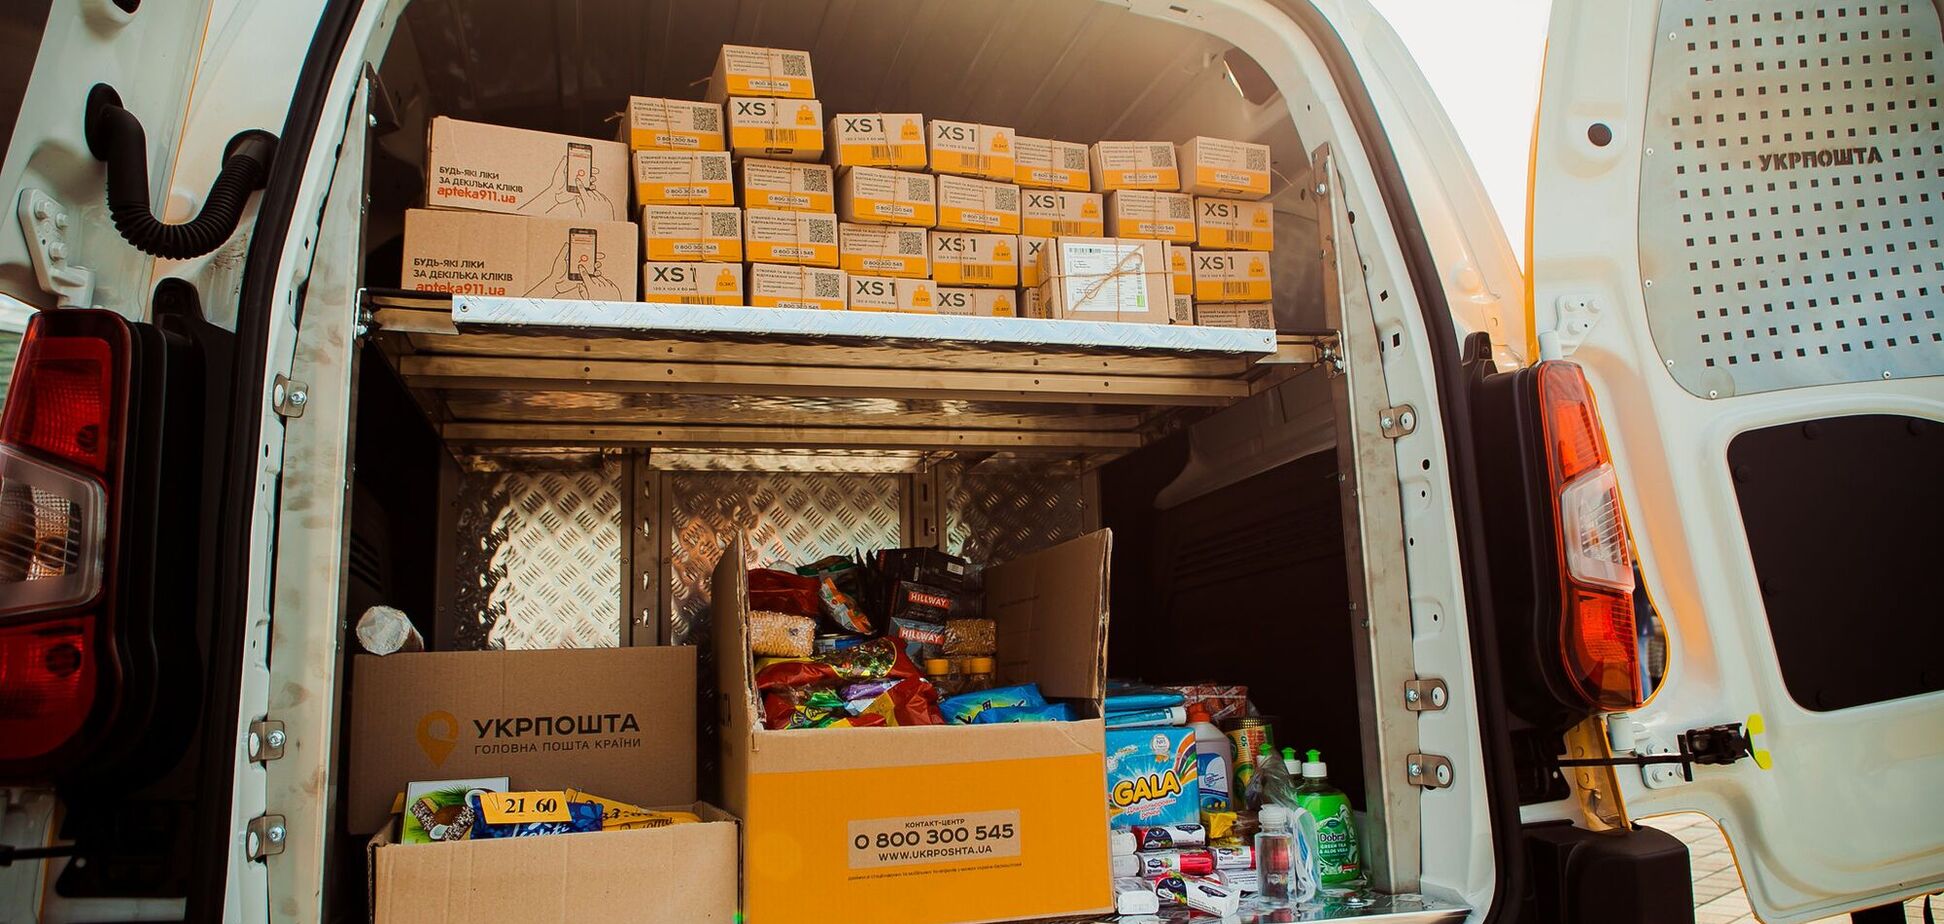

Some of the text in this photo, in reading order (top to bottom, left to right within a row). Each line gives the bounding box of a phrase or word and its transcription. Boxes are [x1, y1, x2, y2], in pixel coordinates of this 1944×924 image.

[738, 102, 766, 116] XS
[845, 119, 884, 133] XS 1
[938, 125, 975, 143] XS 1
[1758, 147, 1883, 171] УКРПОШТА
[439, 166, 499, 180] БУДЬ-ЯКІ ЛІКИ
[438, 177, 523, 193] ЗА ДЕКІЛЬКА КЛІКІВ
[437, 185, 516, 204] apteka911.ua
[1029, 195, 1065, 210] XS 1
[1205, 203, 1238, 218] XS 1
[939, 238, 976, 252] XS 1
[414, 258, 484, 269] БУДЬ-ЯКІ ЛІКИ
[1200, 256, 1234, 270] XS 1
[413, 269, 513, 281] ЗА ДЕКІЛЬКА КЛІКІВ
[654, 267, 685, 282] XS
[415, 282, 506, 296] apteka911.ua
[857, 281, 896, 297] XS 1
[938, 293, 966, 307] XS
[911, 593, 947, 606] HILLWAY
[473, 712, 640, 739] УКРПОШТА
[474, 737, 641, 755] ГОЛОВНА ПОШТА КРАЇНИ
[1114, 770, 1181, 806] GALA
[905, 818, 965, 828] КОНТАКТ-ЦЕНТР
[854, 824, 1014, 850] 0 800 300 545
[1319, 833, 1345, 843] Dobra
[878, 844, 993, 861] WWW.UKRPOSHTA.UA
